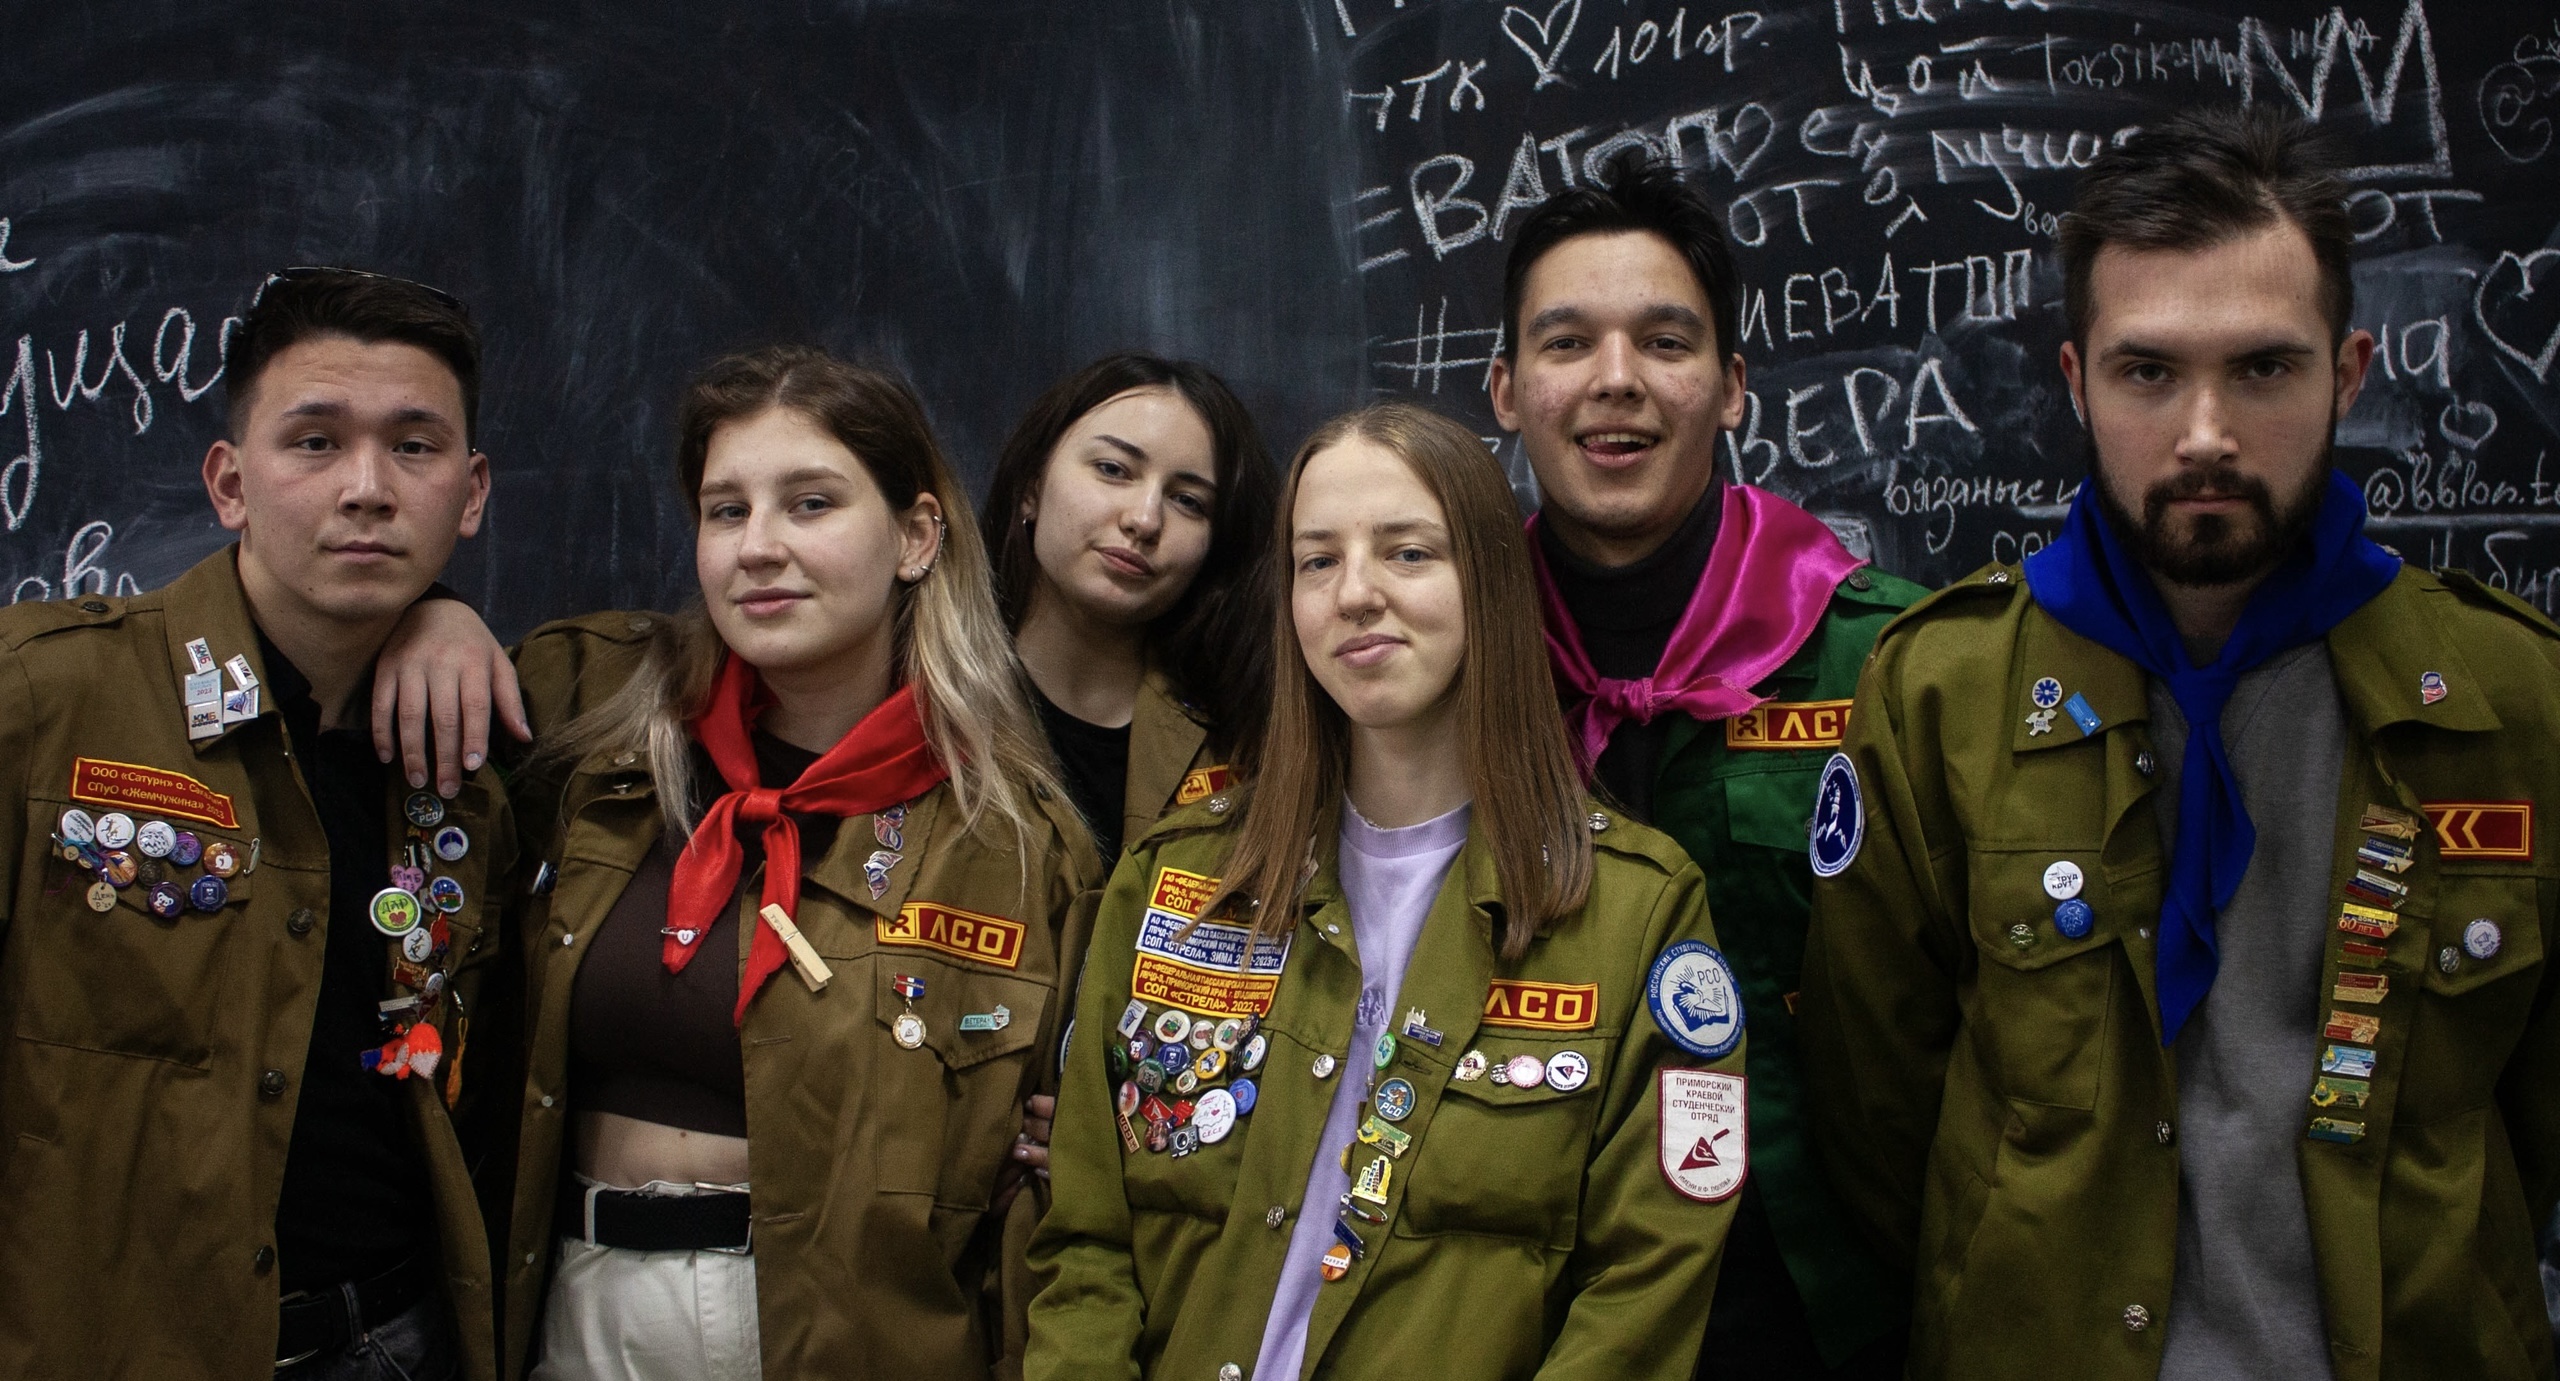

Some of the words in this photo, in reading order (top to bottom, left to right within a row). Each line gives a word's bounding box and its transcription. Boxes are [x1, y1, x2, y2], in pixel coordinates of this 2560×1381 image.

[91, 766, 118, 779] ООО
[120, 772, 174, 788] «Сатурн»
[87, 781, 120, 795] СПуО
[121, 786, 204, 810] «Жемчужина»
[1165, 893, 1192, 911] СОП
[1144, 934, 1163, 949] СОП
[1209, 951, 1234, 964] ЗИМА
[1650, 954, 1673, 999] РОССИЙСКИЕ
[1671, 943, 1717, 958] СТУДЕНЧЕСКИЕ
[1697, 967, 1721, 986] РСО
[1143, 981, 1168, 998] СОП
[1170, 990, 1230, 1013] «СТРЕЛА»,
[1231, 1000, 1254, 1013] 2022
[1676, 1077, 1732, 1092] ПРИМОРСКИЙ
[1686, 1089, 1723, 1102] КРАЕВОЙ
[1672, 1099, 1736, 1114] СТУДЕНЧЕСКИЙ
[1690, 1111, 1719, 1124] ОТРЯД
